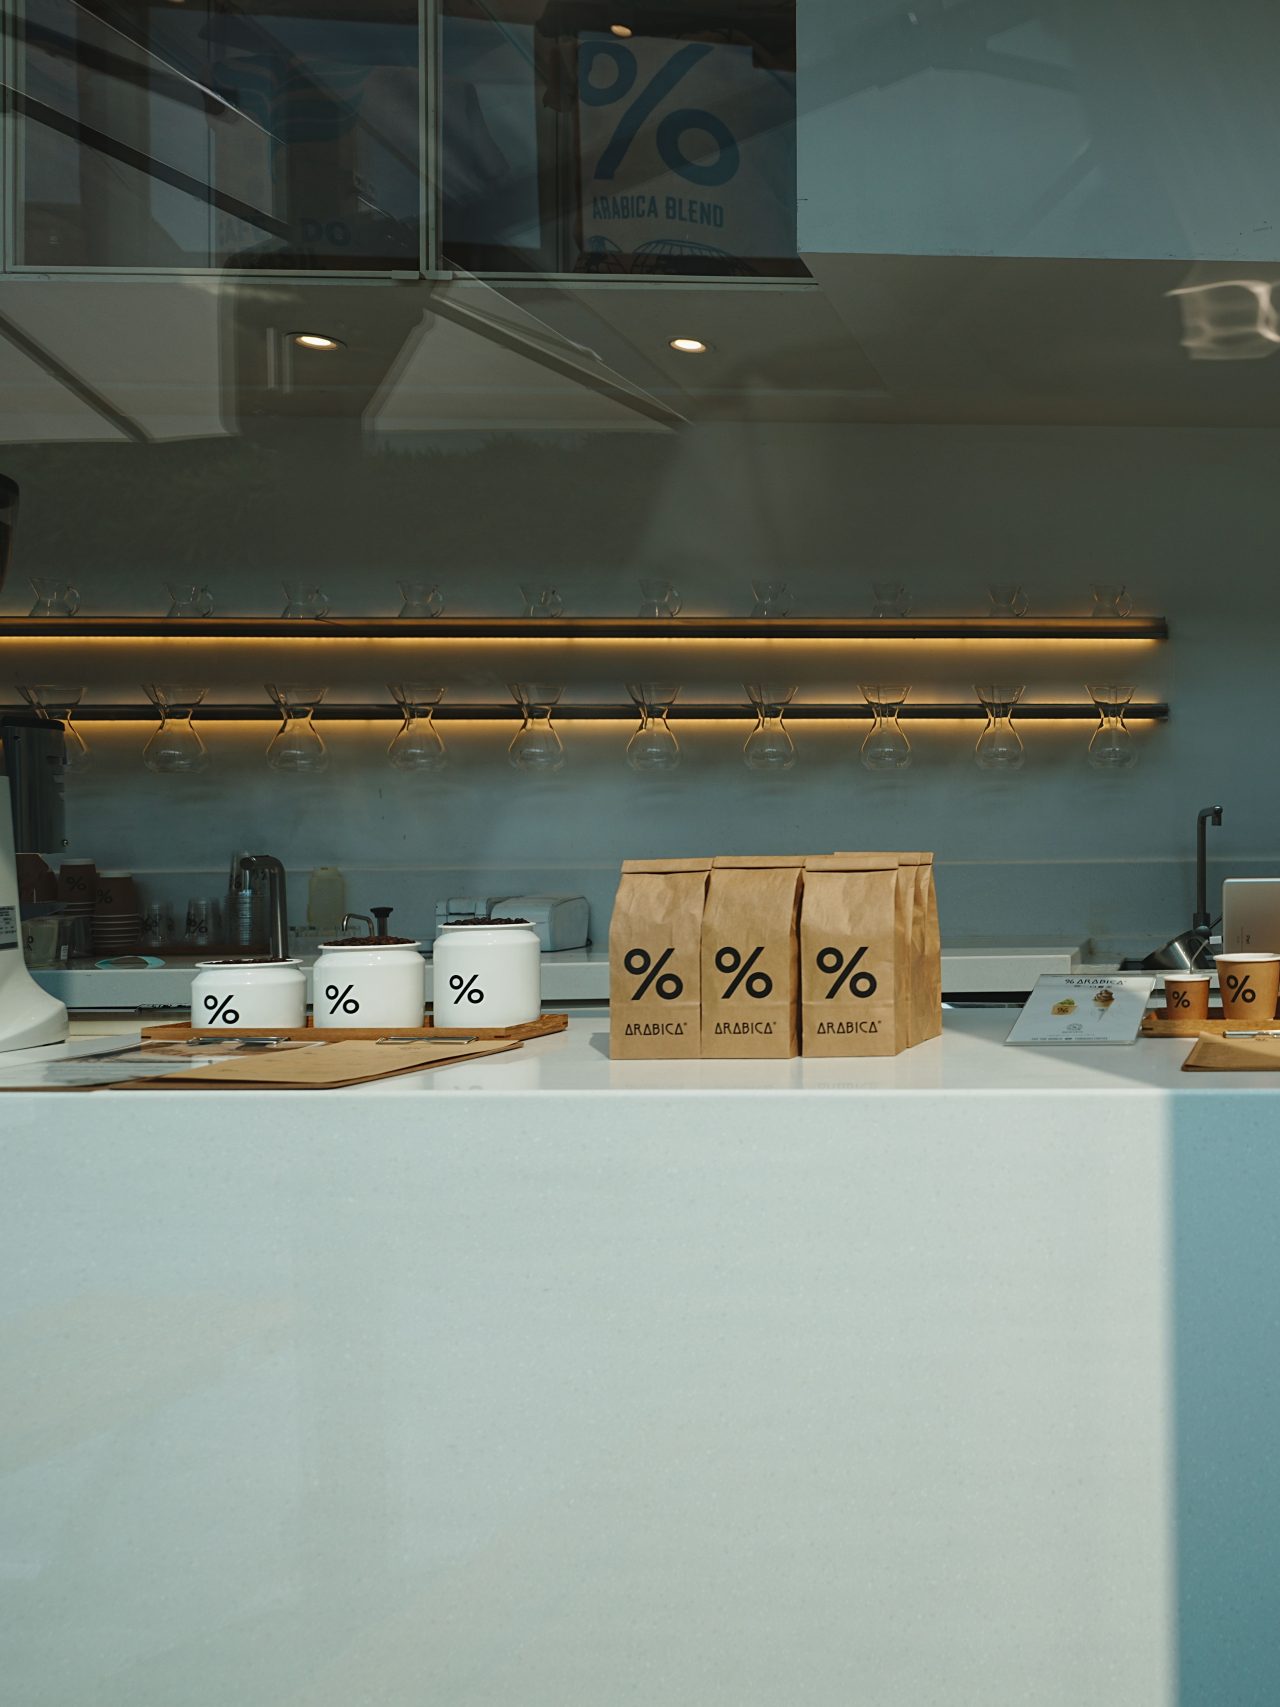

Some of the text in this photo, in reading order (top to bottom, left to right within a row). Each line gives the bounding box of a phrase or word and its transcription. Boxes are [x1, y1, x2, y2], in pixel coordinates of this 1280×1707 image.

[592, 195, 725, 228] ARABICA BLEND
[624, 947, 684, 1001] %
[715, 946, 773, 1000] %
[816, 946, 878, 1000] %
[325, 984, 360, 1015] %
[449, 974, 485, 1005] %
[1172, 990, 1191, 1009] %
[1226, 974, 1257, 1004] %
[204, 994, 240, 1025] %
